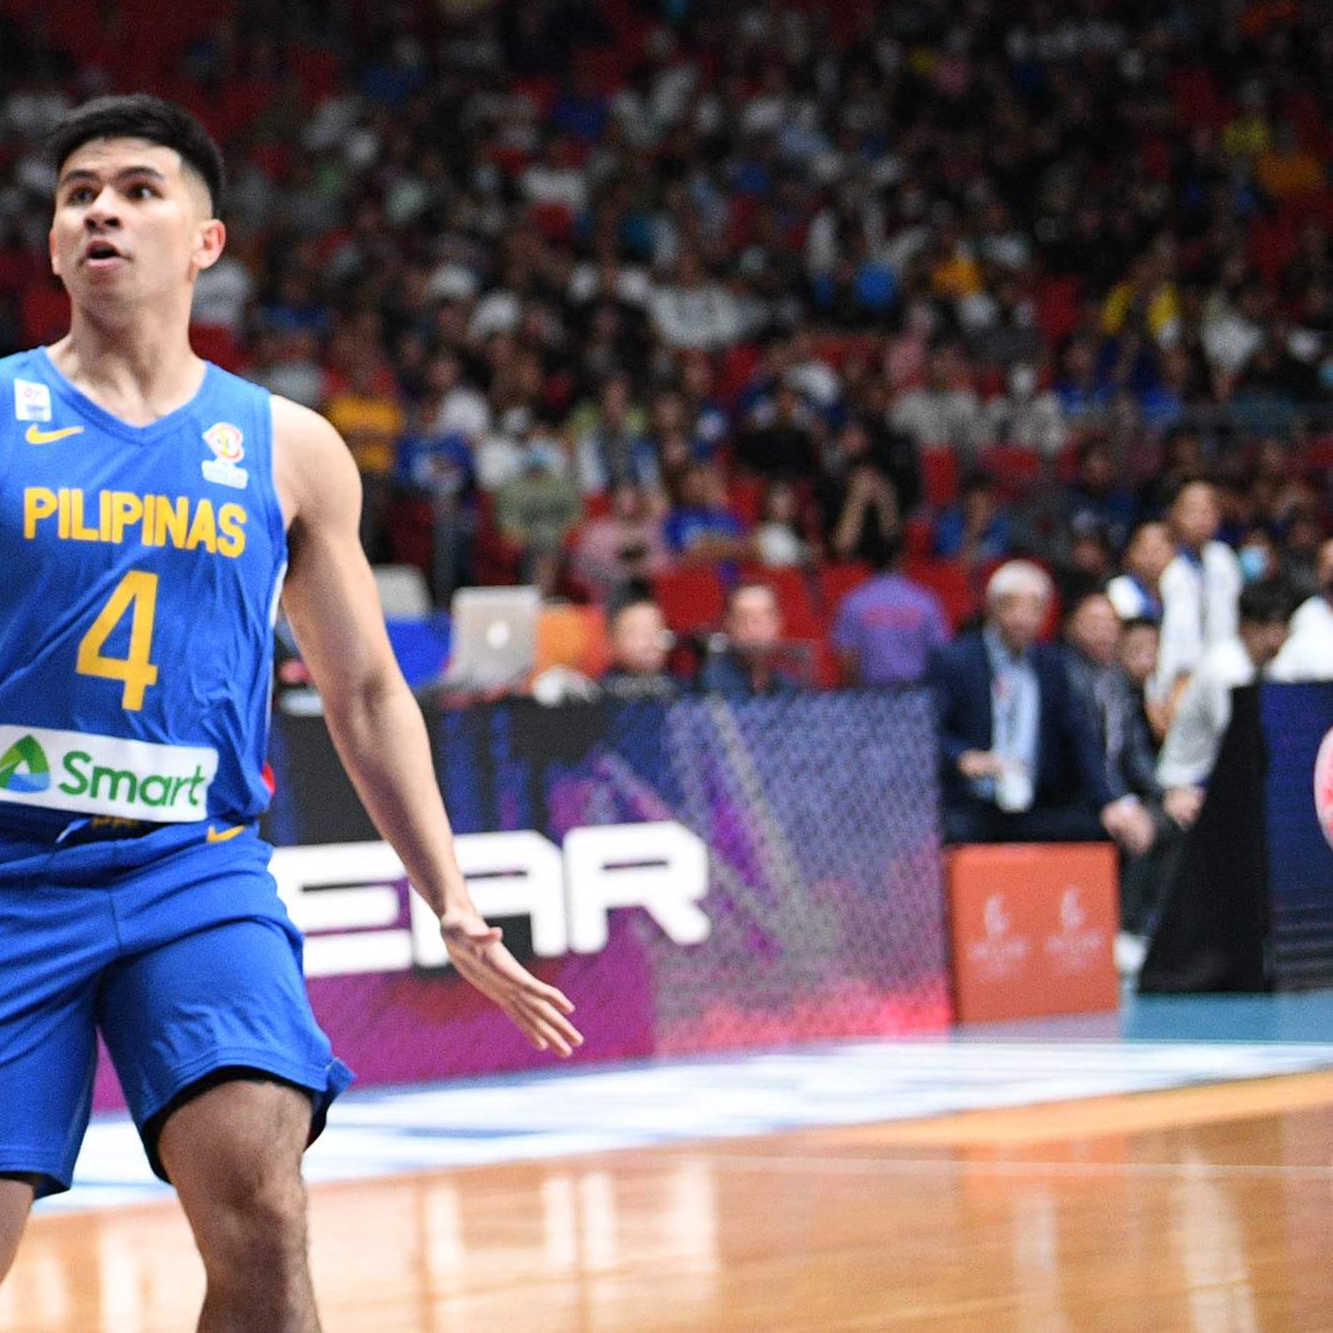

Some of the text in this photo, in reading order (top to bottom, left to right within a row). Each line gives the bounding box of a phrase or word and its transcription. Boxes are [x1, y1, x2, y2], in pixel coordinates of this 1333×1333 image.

[23, 487, 247, 558] PILIPINAS
[75, 569, 159, 712] 4
[58, 750, 206, 807] Smart
